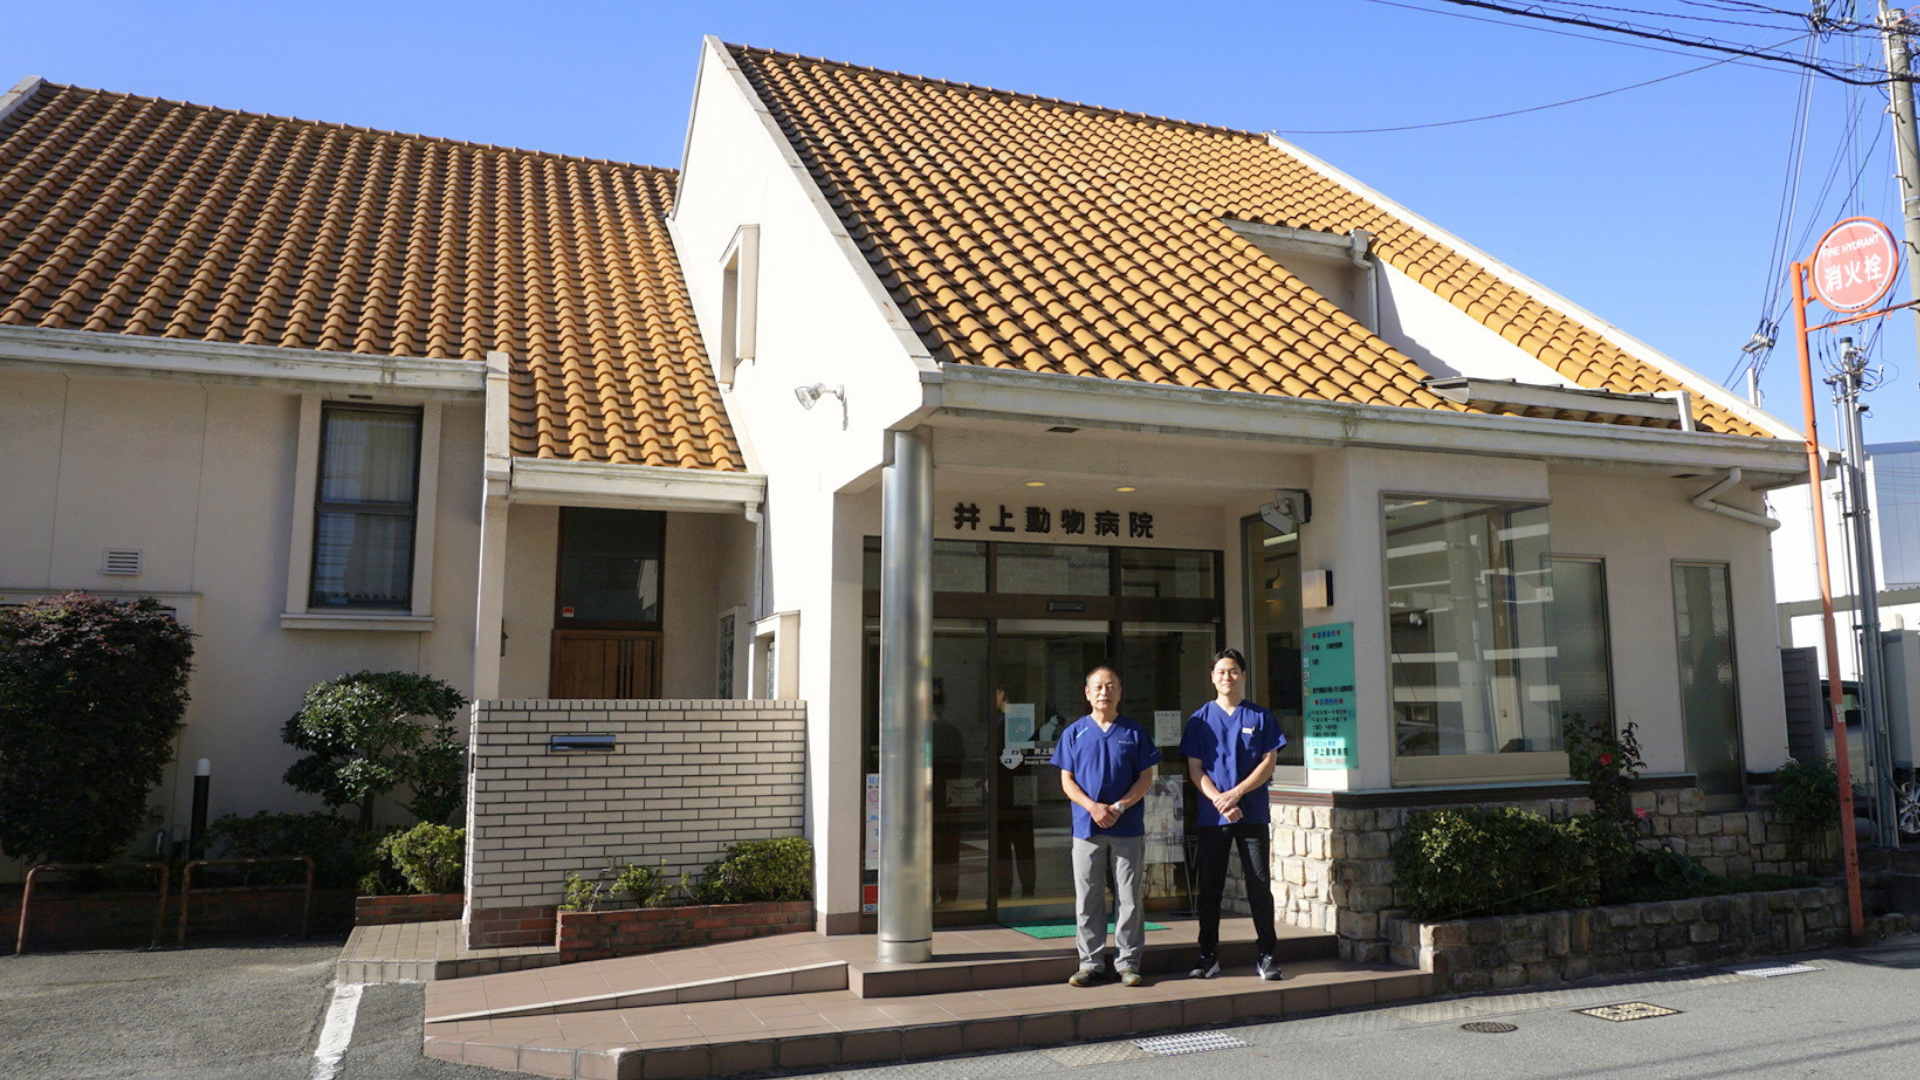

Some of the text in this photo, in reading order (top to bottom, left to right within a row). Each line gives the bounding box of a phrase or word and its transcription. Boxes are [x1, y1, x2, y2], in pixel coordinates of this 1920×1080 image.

[1822, 234, 1880, 258] FIRE HYDRANT
[1824, 253, 1883, 292] 消火栓
[953, 502, 1154, 539] 井上動物病院
